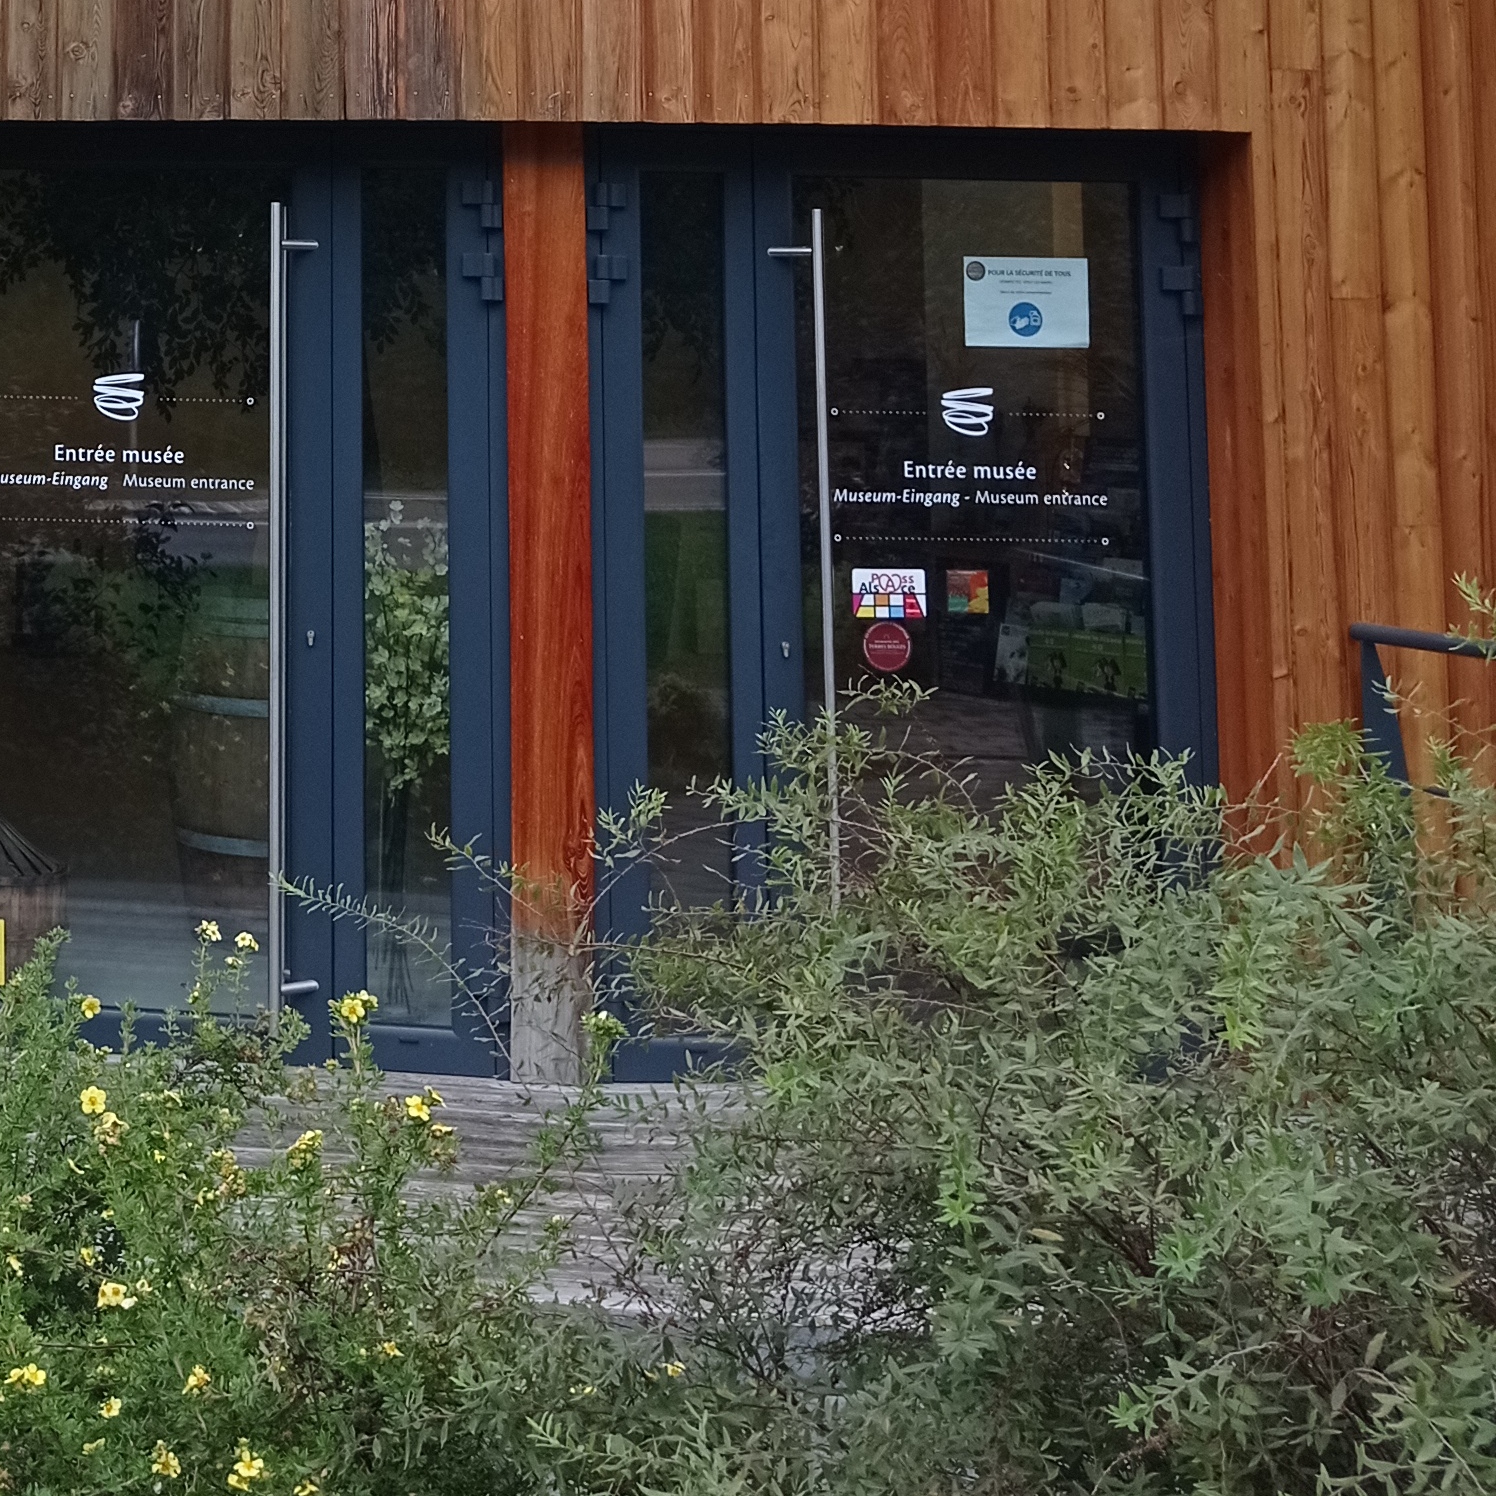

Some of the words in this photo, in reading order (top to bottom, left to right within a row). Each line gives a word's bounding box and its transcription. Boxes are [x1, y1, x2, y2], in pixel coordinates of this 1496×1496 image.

[54, 443, 116, 463] Entrée
[122, 445, 185, 464] musée
[904, 460, 967, 480] Entrée
[973, 461, 1037, 480] musée
[123, 473, 186, 489] Museum
[190, 476, 255, 490] entrance
[833, 488, 961, 507] Museum-Eingang
[975, 490, 1039, 505] Museum
[1043, 491, 1108, 506] entrance
